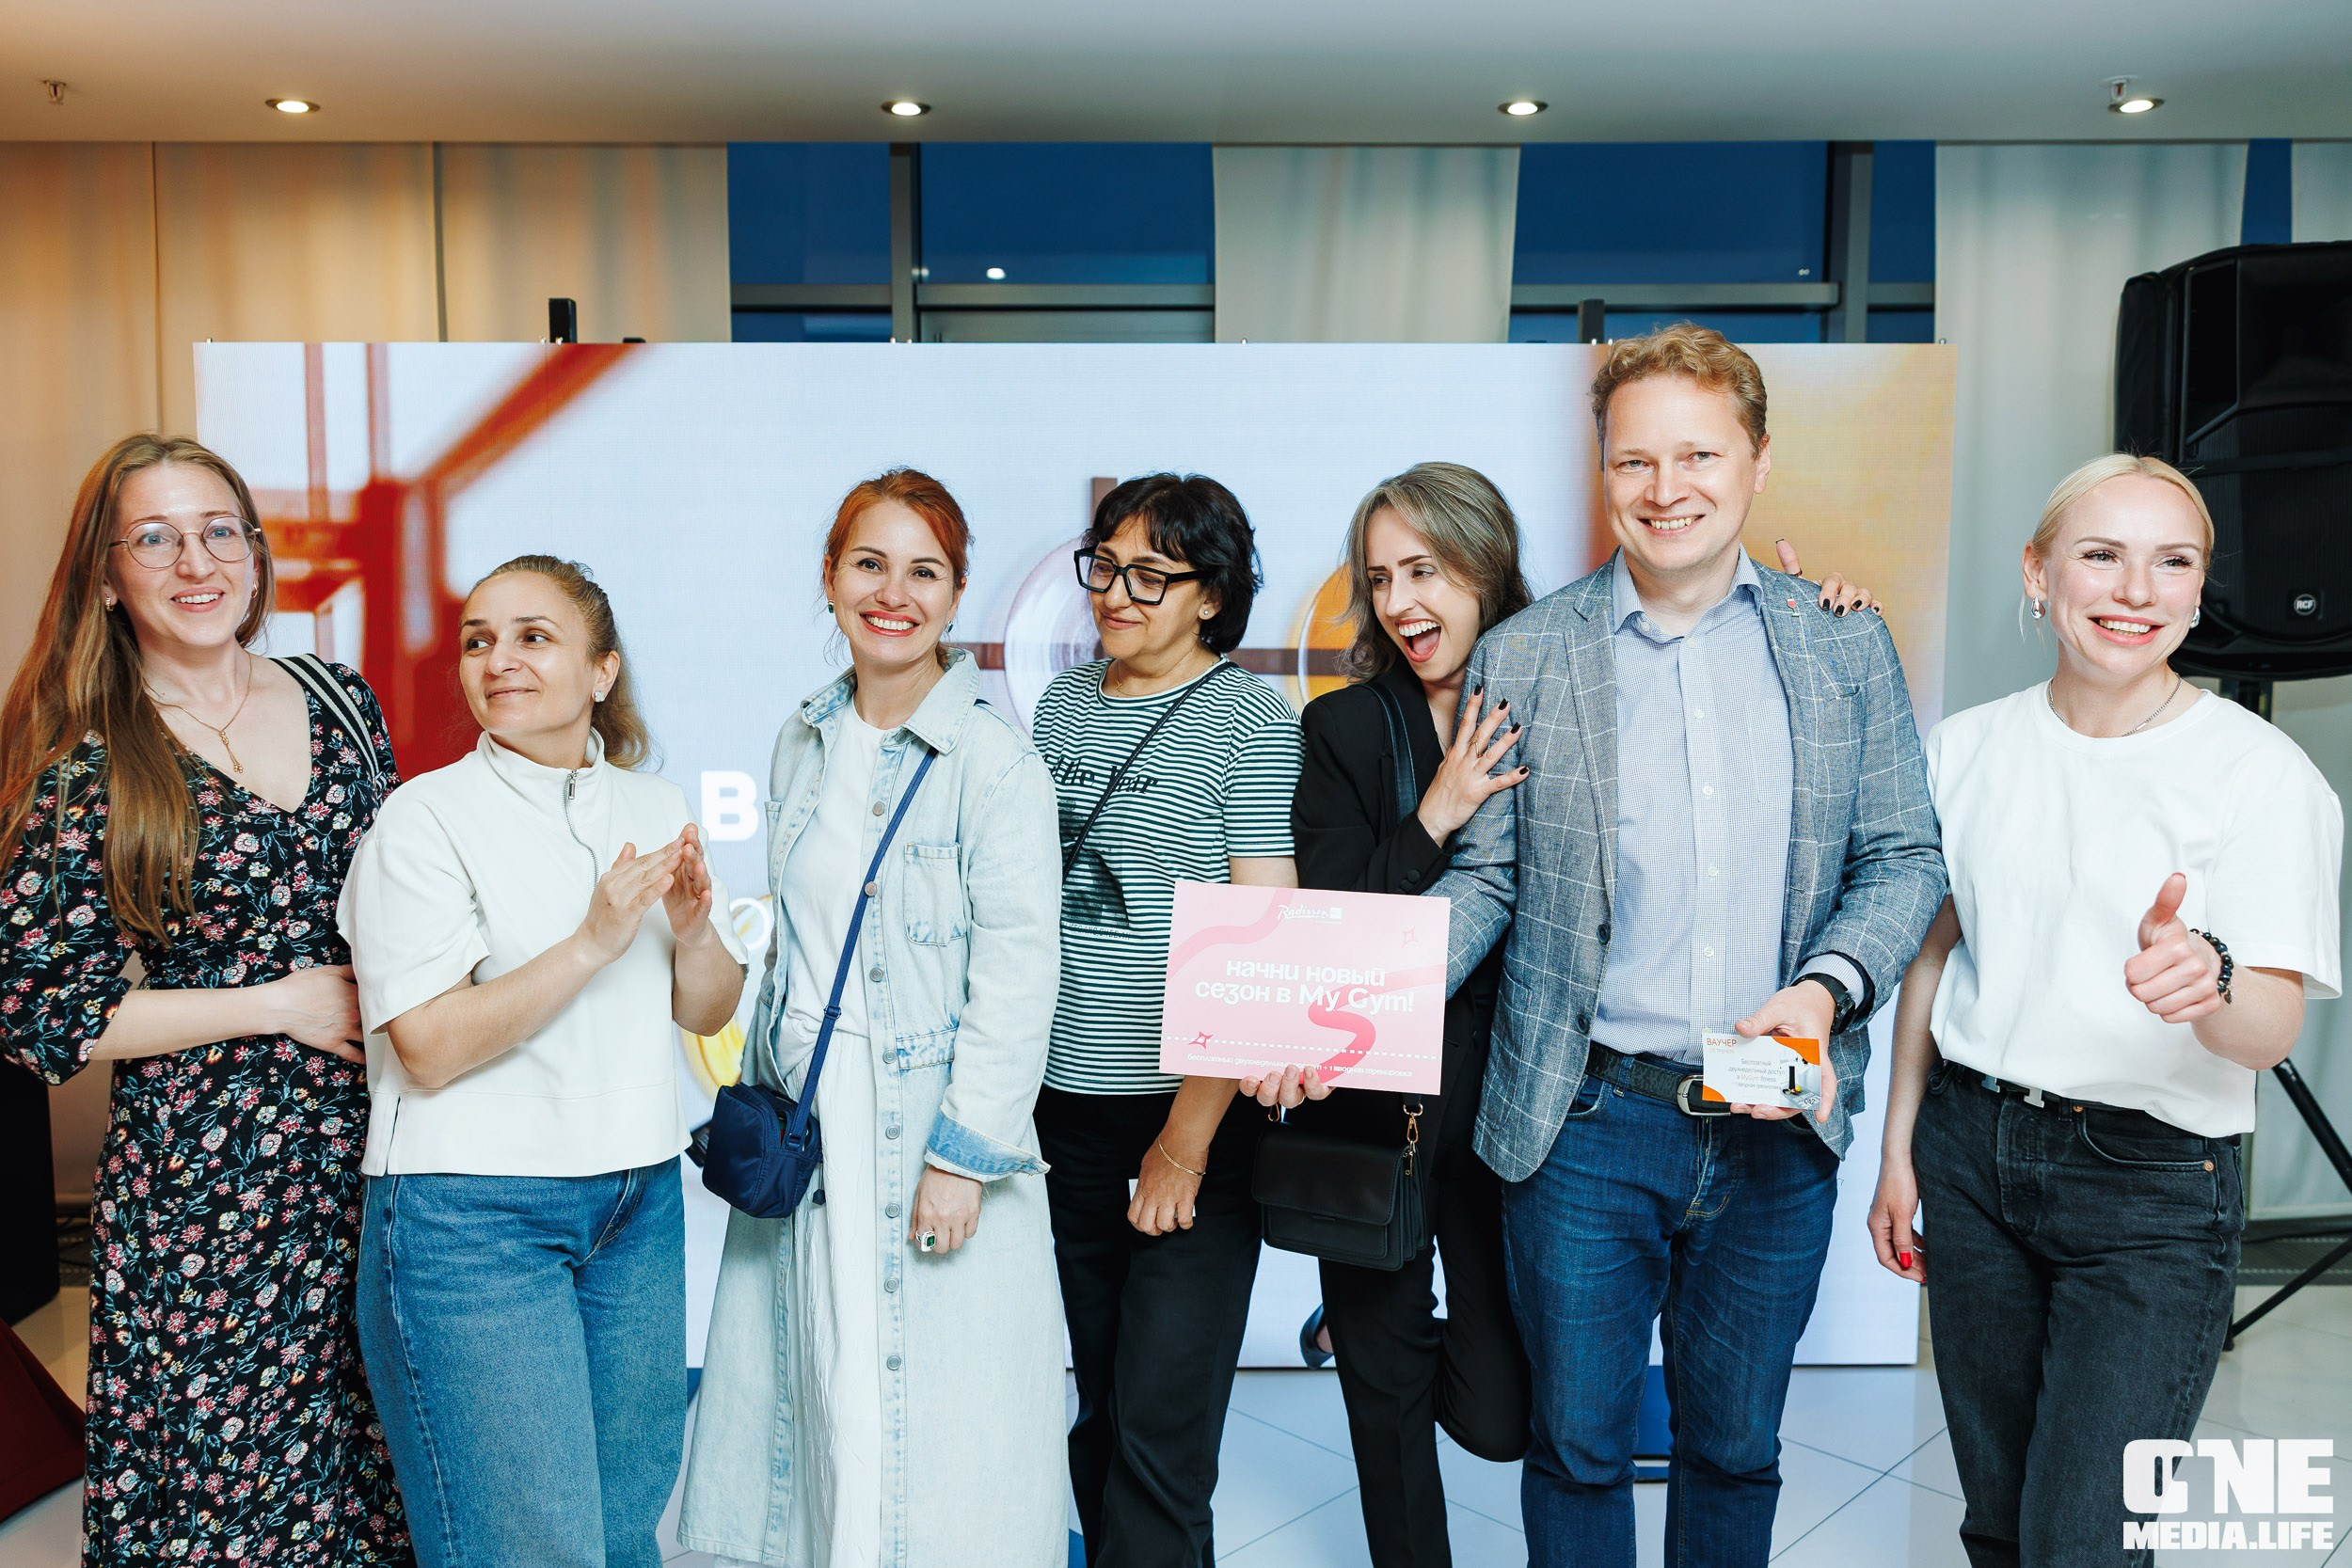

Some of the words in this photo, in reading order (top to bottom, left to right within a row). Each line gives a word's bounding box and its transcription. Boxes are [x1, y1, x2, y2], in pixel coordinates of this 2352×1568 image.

[2296, 600, 2313, 610] RCF
[1278, 903, 1328, 921] Radisson
[1226, 959, 1298, 981] начни
[1306, 964, 1385, 987] новый
[1195, 980, 1270, 1006] сезон
[1277, 987, 1292, 1004] в
[1298, 984, 1340, 1012] My
[1347, 988, 1414, 1016] Gym!
[1707, 1037, 1737, 1047] ВАУЧЕР
[1187, 1053, 1233, 1064] бесплатный
[1365, 1067, 1412, 1077] тренировка
